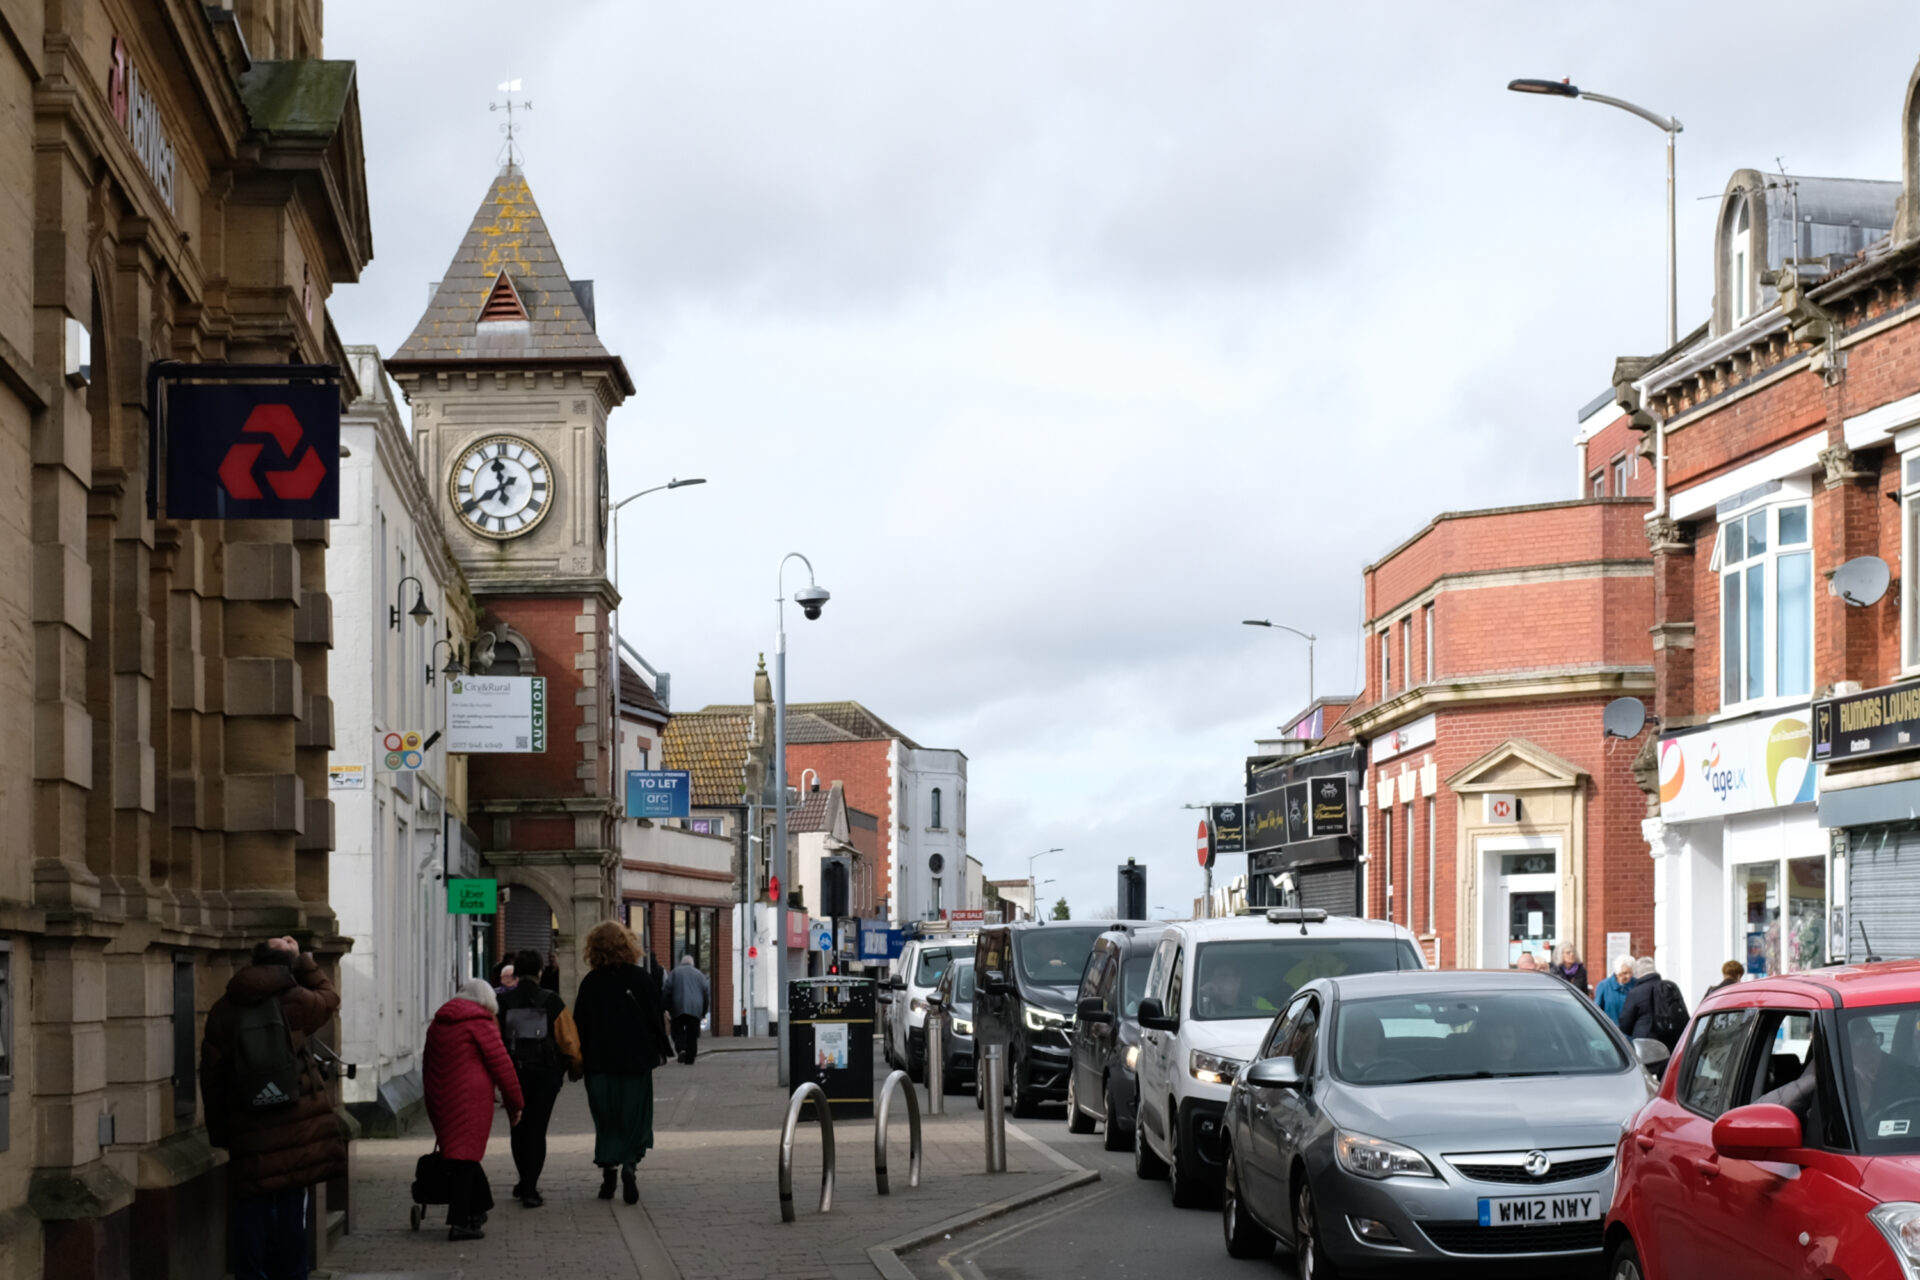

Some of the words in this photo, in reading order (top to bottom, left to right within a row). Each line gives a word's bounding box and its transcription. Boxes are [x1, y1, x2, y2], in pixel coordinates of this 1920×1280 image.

[128, 55, 176, 217] NatWest
[464, 682, 511, 692] City&Rural
[532, 680, 543, 749] AUCTION
[1840, 697, 1882, 733] RUMORS
[1883, 688, 1920, 725] LOUNG
[640, 779, 655, 789] TO
[658, 779, 678, 789] LET
[1712, 770, 1733, 801] age
[646, 794, 668, 803] arc
[460, 890, 484, 898] Uber
[460, 899, 485, 908] Eats
[1499, 1200, 1546, 1221] WM12
[1552, 1197, 1592, 1219] NWY
